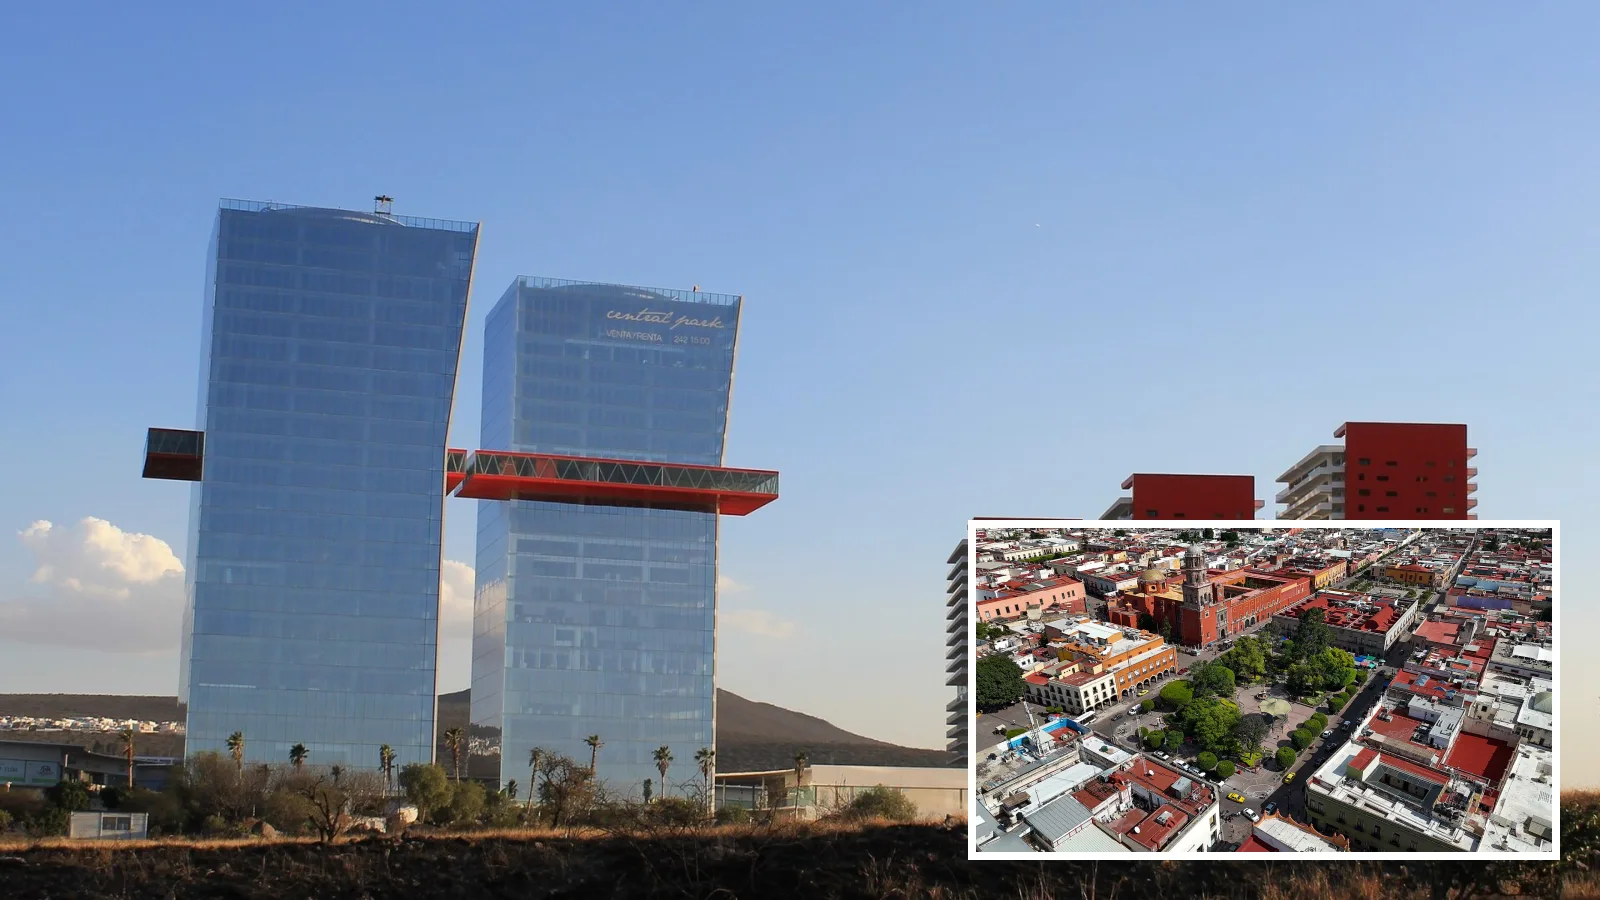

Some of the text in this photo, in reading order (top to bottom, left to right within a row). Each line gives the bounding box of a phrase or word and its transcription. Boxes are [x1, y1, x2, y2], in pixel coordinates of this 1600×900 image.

[607, 308, 724, 330] central park
[606, 329, 663, 341] VENTA/RENTA
